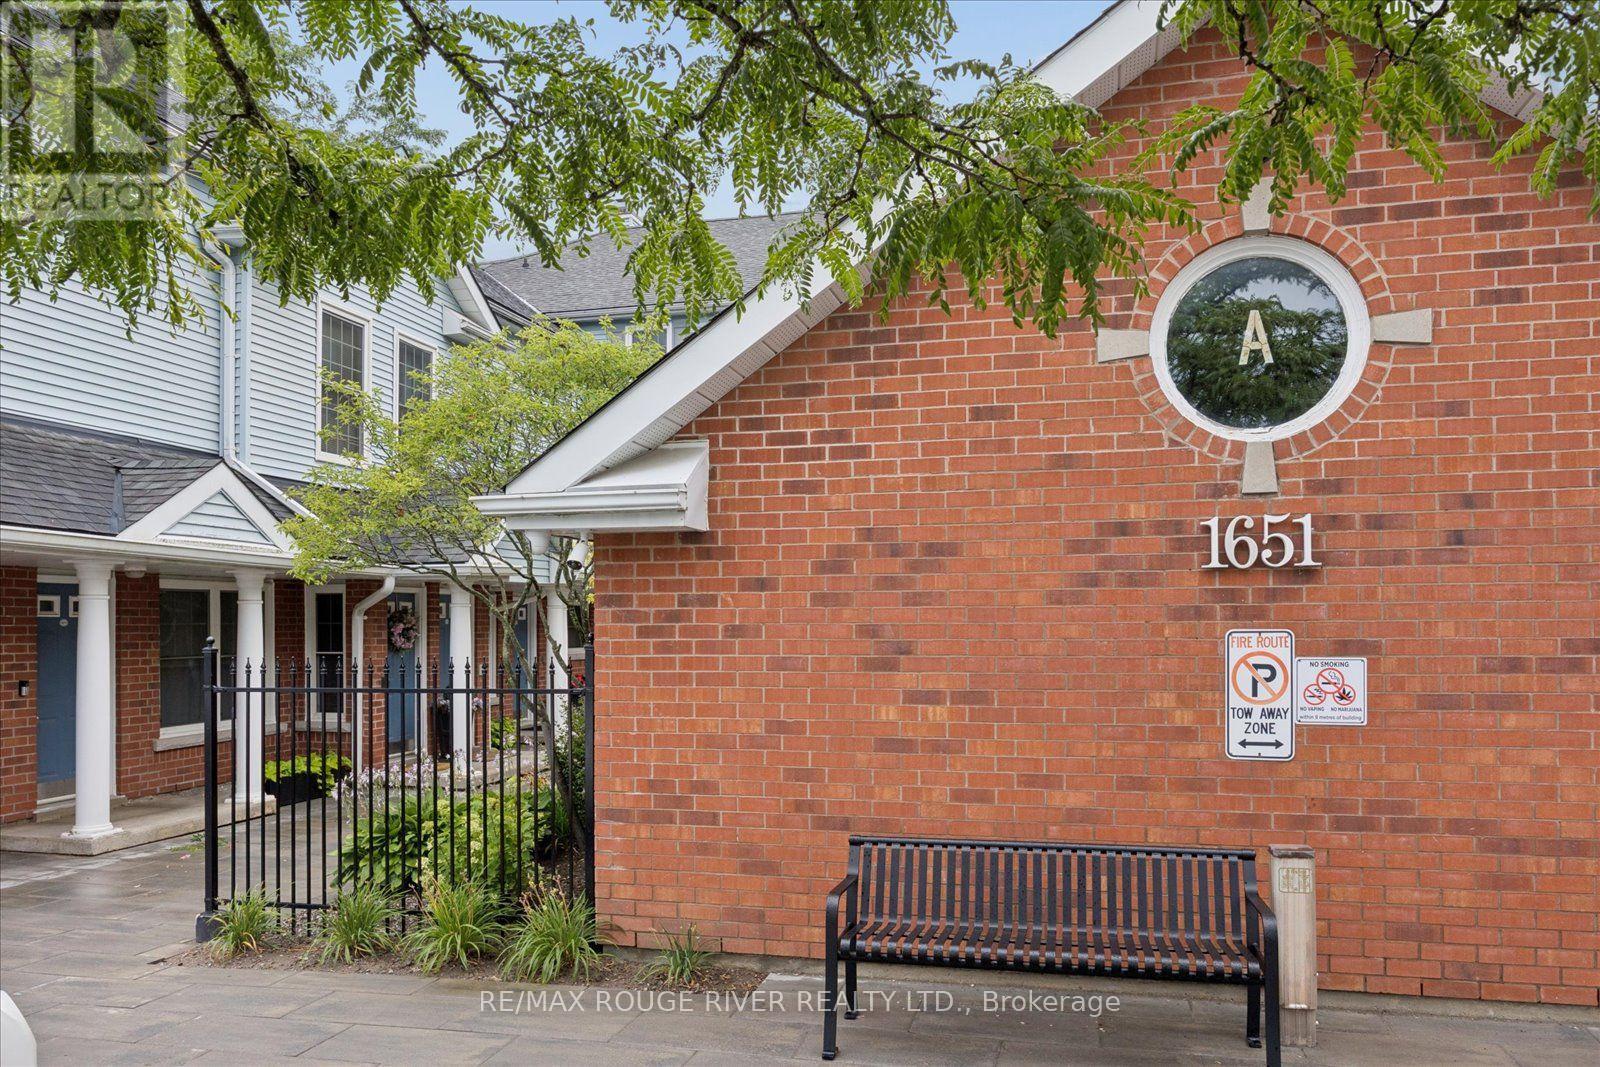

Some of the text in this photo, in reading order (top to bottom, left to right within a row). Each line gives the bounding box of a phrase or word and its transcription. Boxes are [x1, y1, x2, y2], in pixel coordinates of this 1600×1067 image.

[1238, 309, 1274, 365] A
[1199, 512, 1322, 569] 1651
[1231, 636, 1289, 648] FIRE ROUTE
[1252, 664, 1277, 697] P
[1231, 707, 1289, 719] TOW AWAY
[1245, 722, 1276, 734] ZONE
